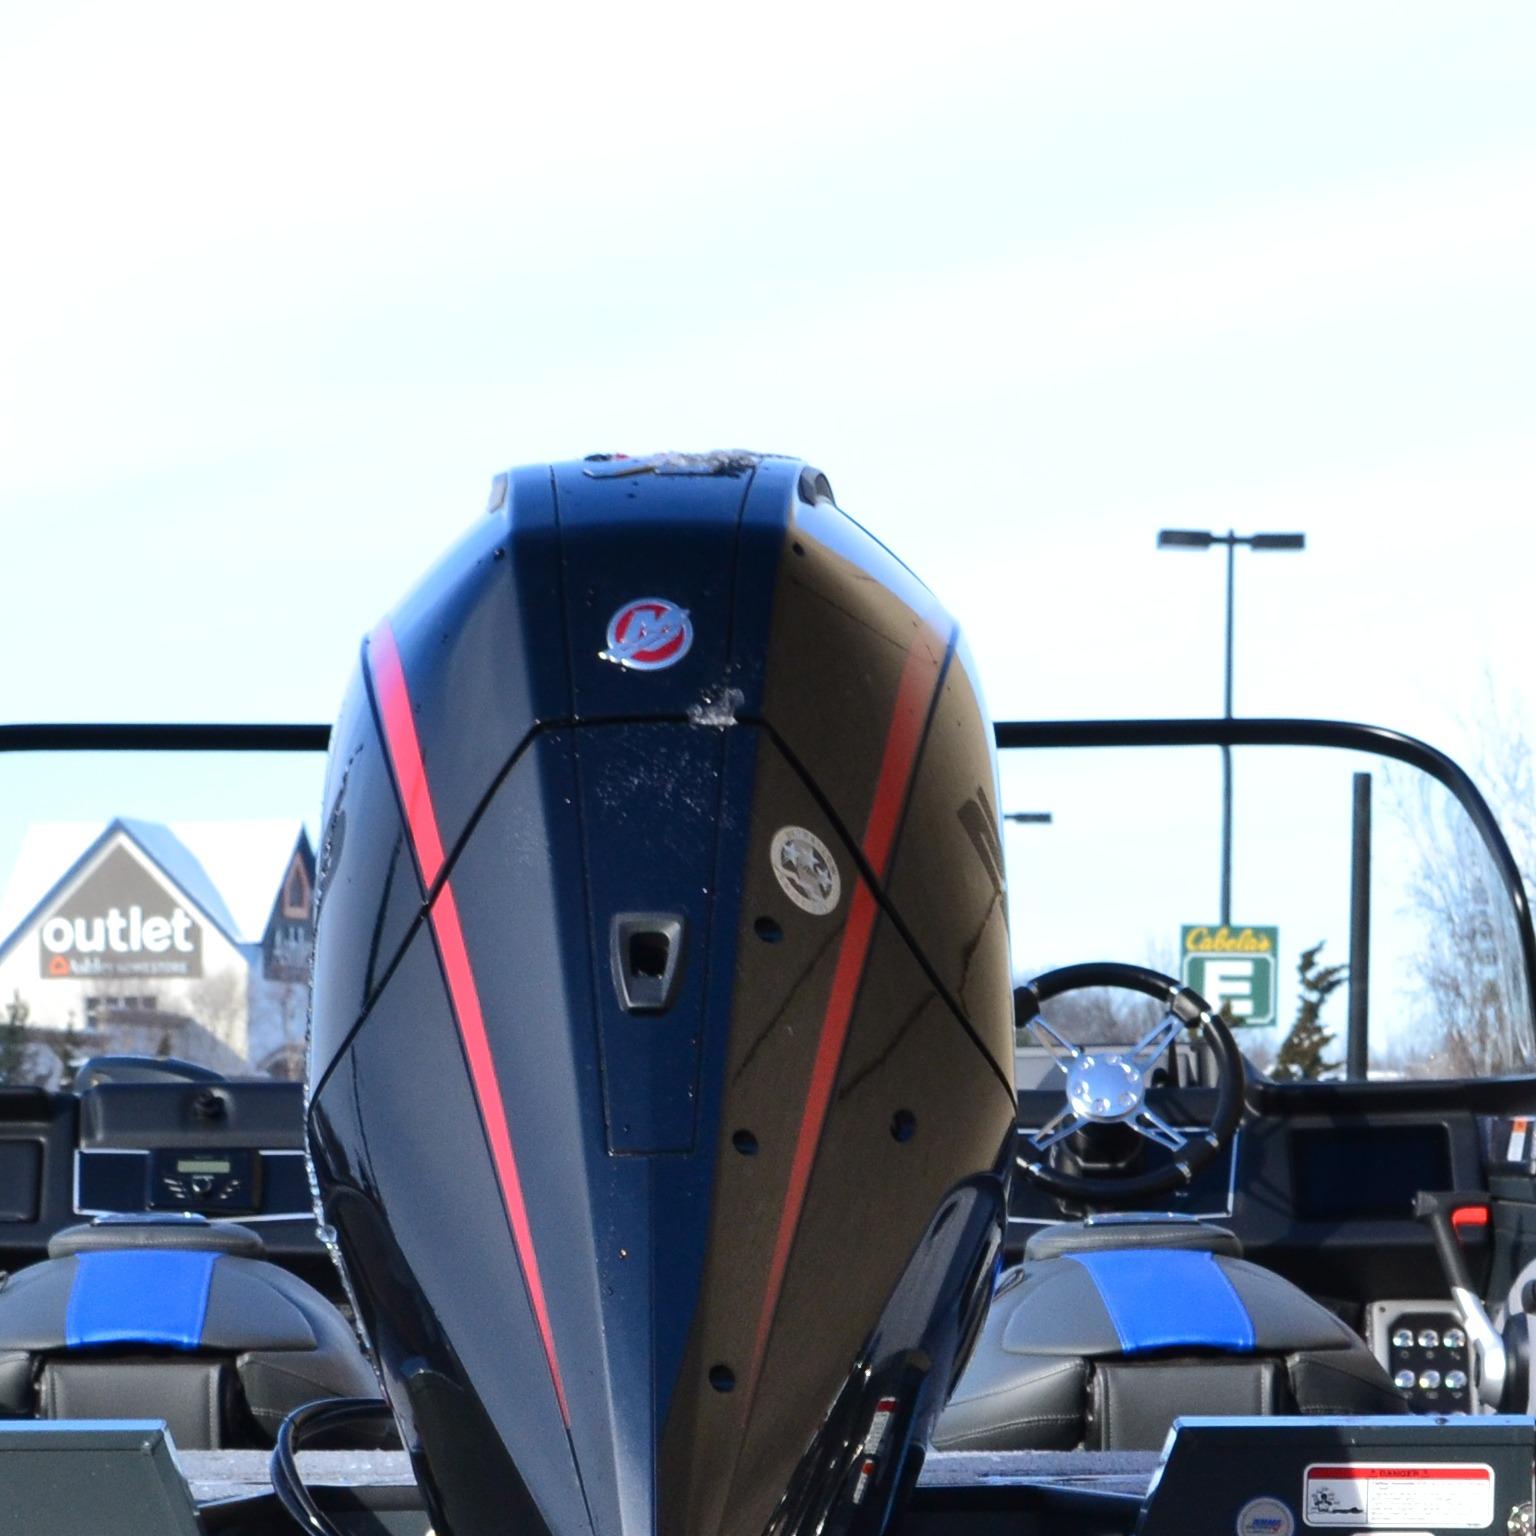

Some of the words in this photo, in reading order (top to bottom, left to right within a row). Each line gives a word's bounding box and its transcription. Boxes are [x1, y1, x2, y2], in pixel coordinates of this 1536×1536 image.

[42, 906, 194, 953] outlet
[1203, 959, 1254, 1016] E
[1378, 1469, 1421, 1478] DANGER
